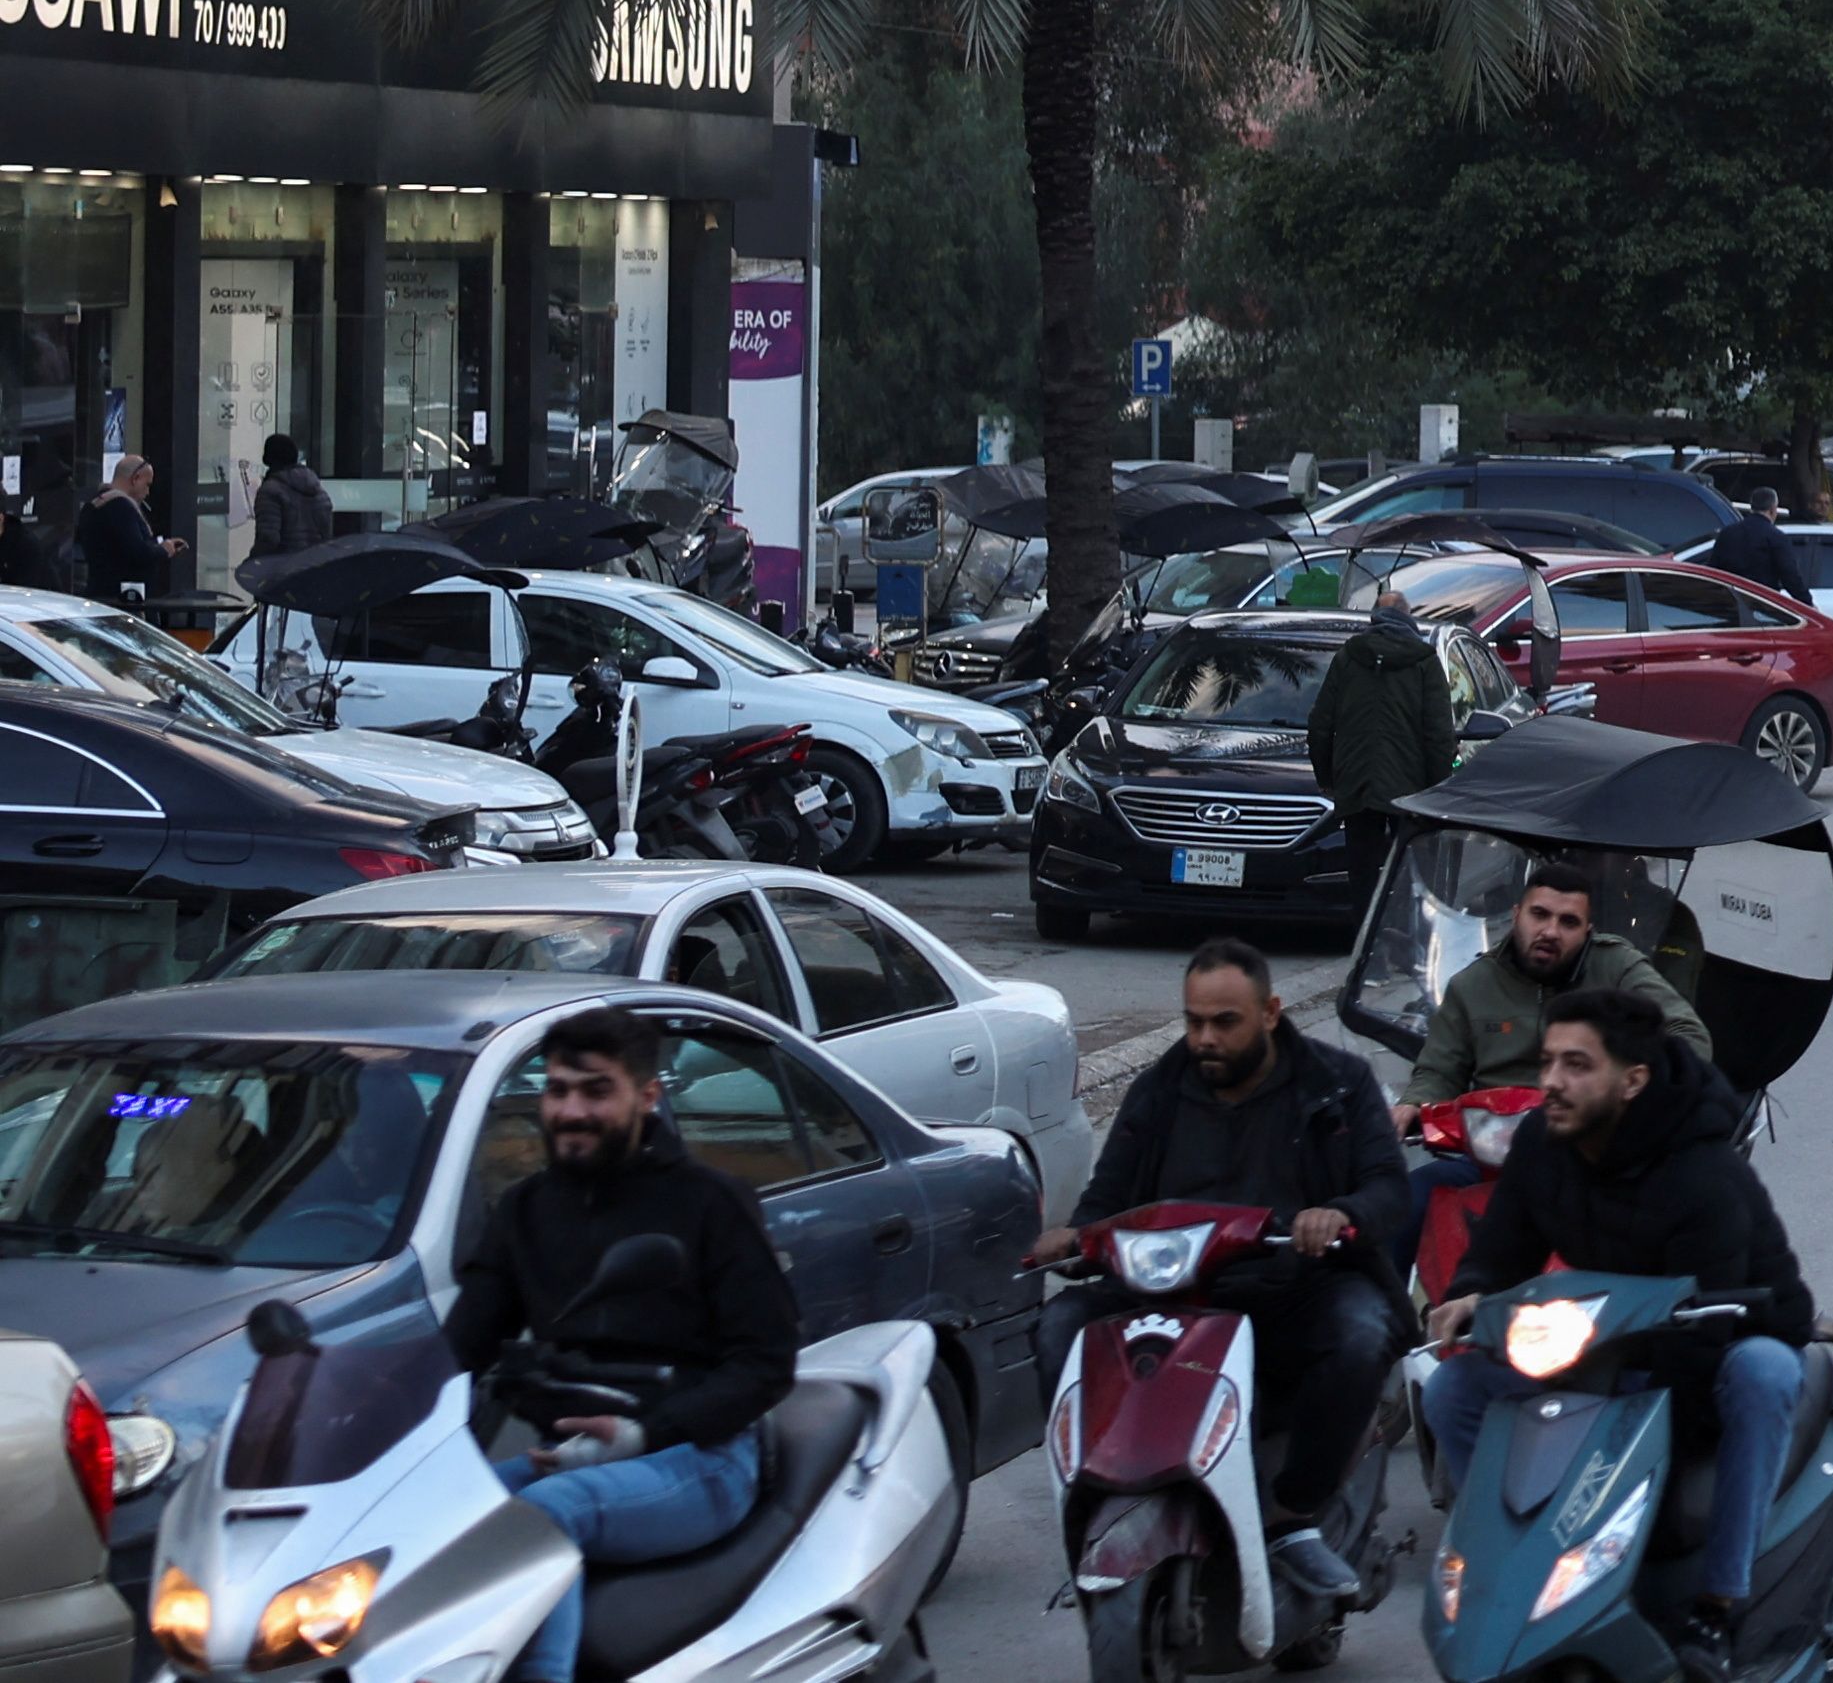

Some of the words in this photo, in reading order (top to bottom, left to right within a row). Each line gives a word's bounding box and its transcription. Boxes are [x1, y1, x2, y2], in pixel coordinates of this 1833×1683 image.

[194, 0, 214, 45] 70
[227, 2, 255, 48] 999
[209, 287, 256, 300] Gaaxy
[734, 309, 766, 329] ERA
[769, 309, 793, 329] OF
[1141, 344, 1163, 382] P
